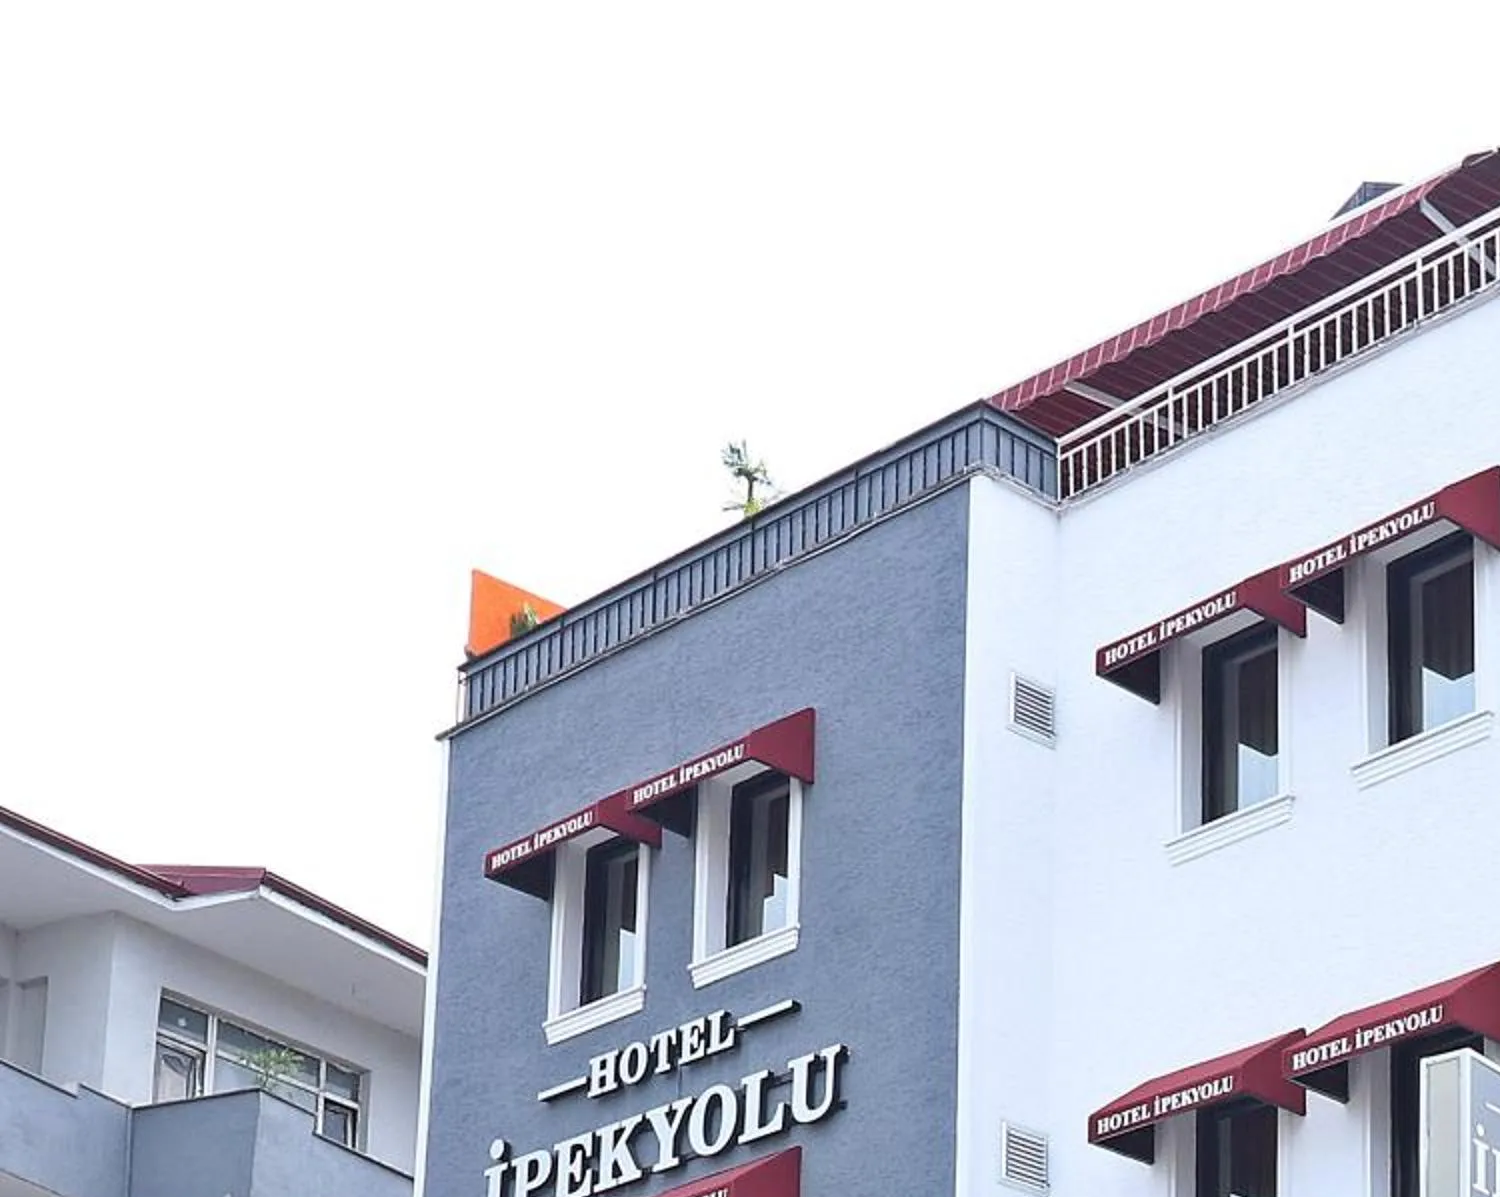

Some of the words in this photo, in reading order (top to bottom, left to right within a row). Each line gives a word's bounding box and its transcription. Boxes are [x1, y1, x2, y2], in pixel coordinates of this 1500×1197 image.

[1289, 544, 1348, 583] HOTEL
[1349, 502, 1436, 554] İPEKYOLU
[1104, 630, 1157, 667] HOTEL
[1159, 591, 1238, 641] İPEKYOLU
[632, 774, 678, 805] HOTEL
[679, 744, 745, 784] İPEKYOLU
[491, 841, 532, 870] HOTEL
[533, 811, 594, 850] İPEKYOLU
[587, 1009, 735, 1098] HOTEL
[1292, 1037, 1351, 1071] HOTEL
[1355, 1004, 1445, 1049] İPEKYOLU
[1097, 1104, 1150, 1135] HOTEL
[1153, 1075, 1234, 1116] İPEKYOLU
